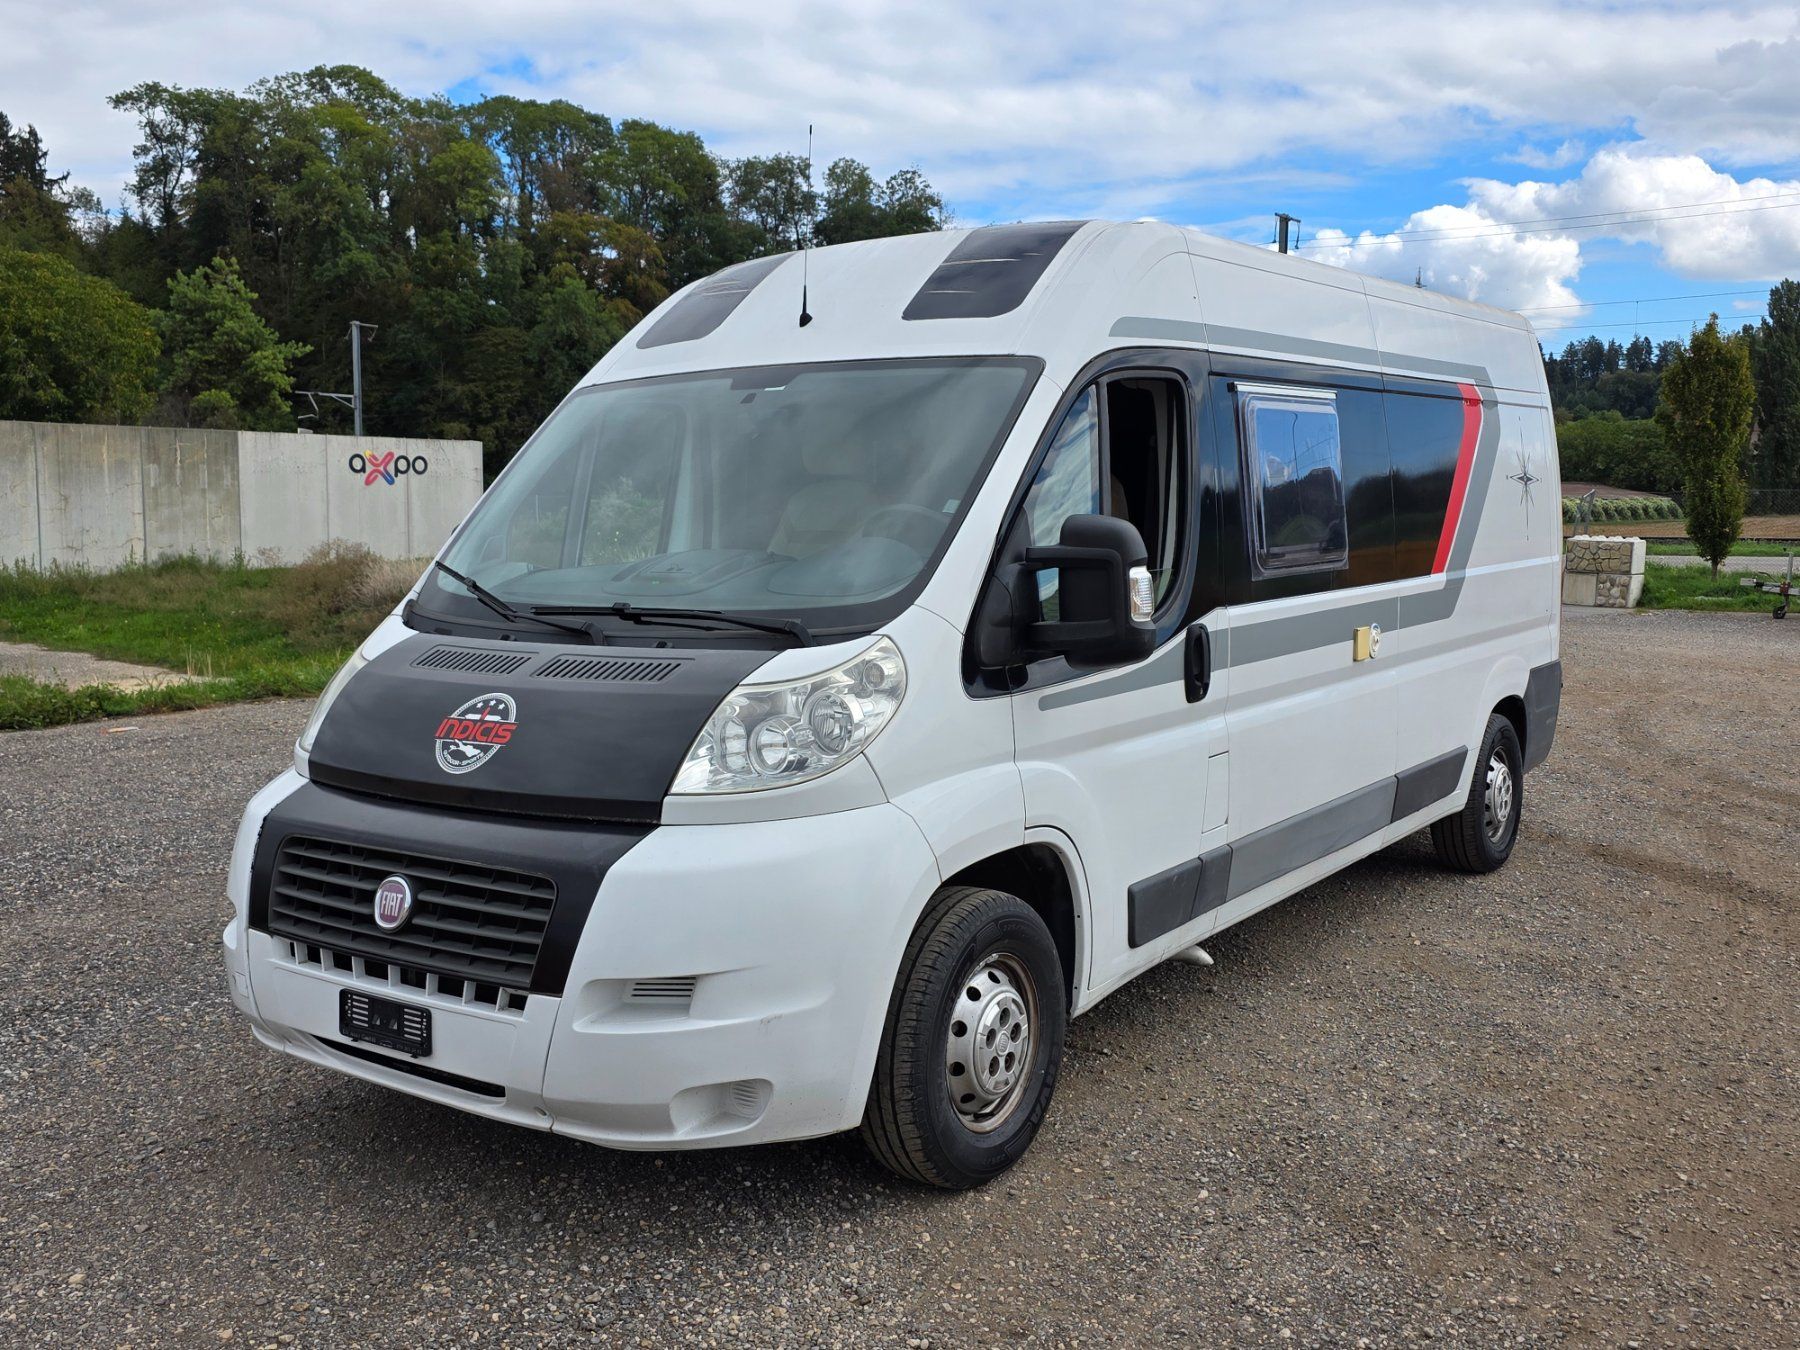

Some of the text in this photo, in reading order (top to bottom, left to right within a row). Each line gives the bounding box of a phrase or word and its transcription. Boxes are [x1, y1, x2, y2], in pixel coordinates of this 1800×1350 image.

[349, 449, 428, 486] axpo
[435, 718, 518, 744] INDICIS
[381, 891, 404, 917] FIAT
